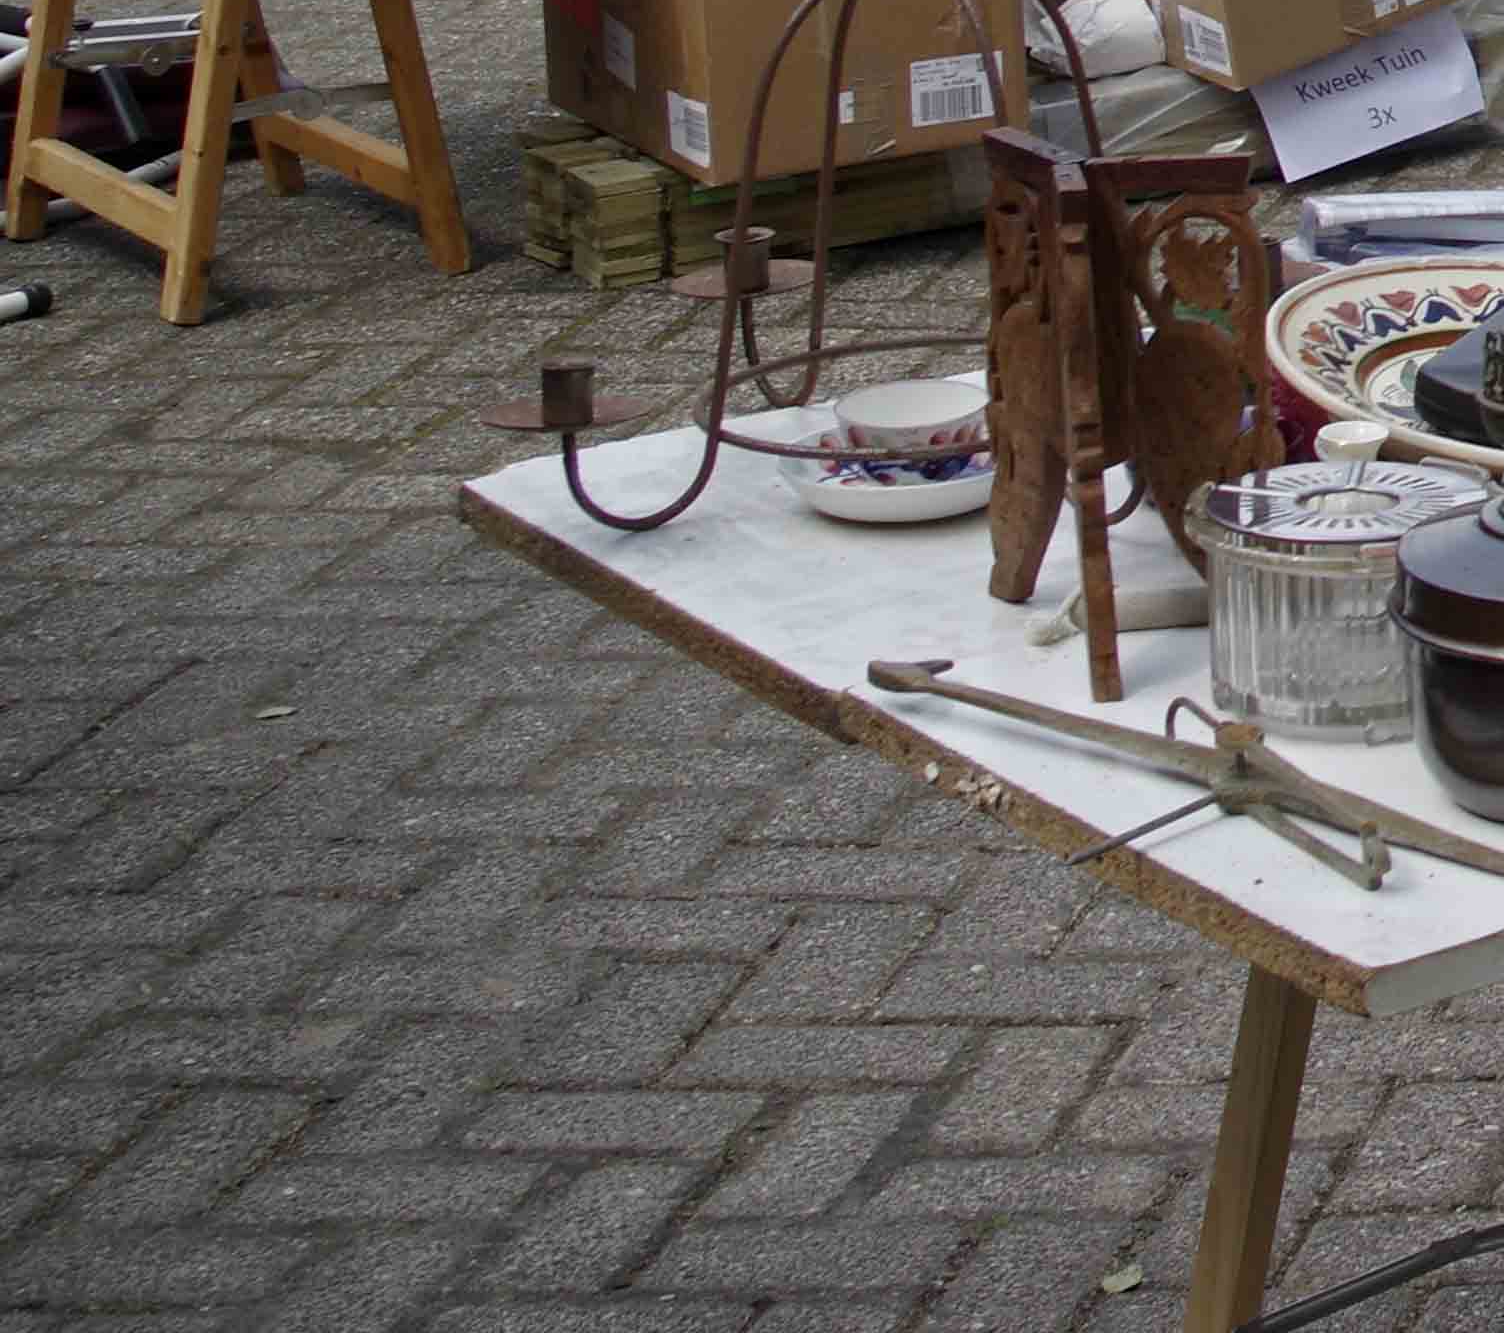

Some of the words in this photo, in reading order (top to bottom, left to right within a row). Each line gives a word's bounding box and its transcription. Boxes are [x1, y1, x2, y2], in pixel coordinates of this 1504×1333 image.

[1295, 65, 1374, 103] Kweek
[1372, 45, 1428, 75] Tuin
[1367, 105, 1397, 129] 3x
